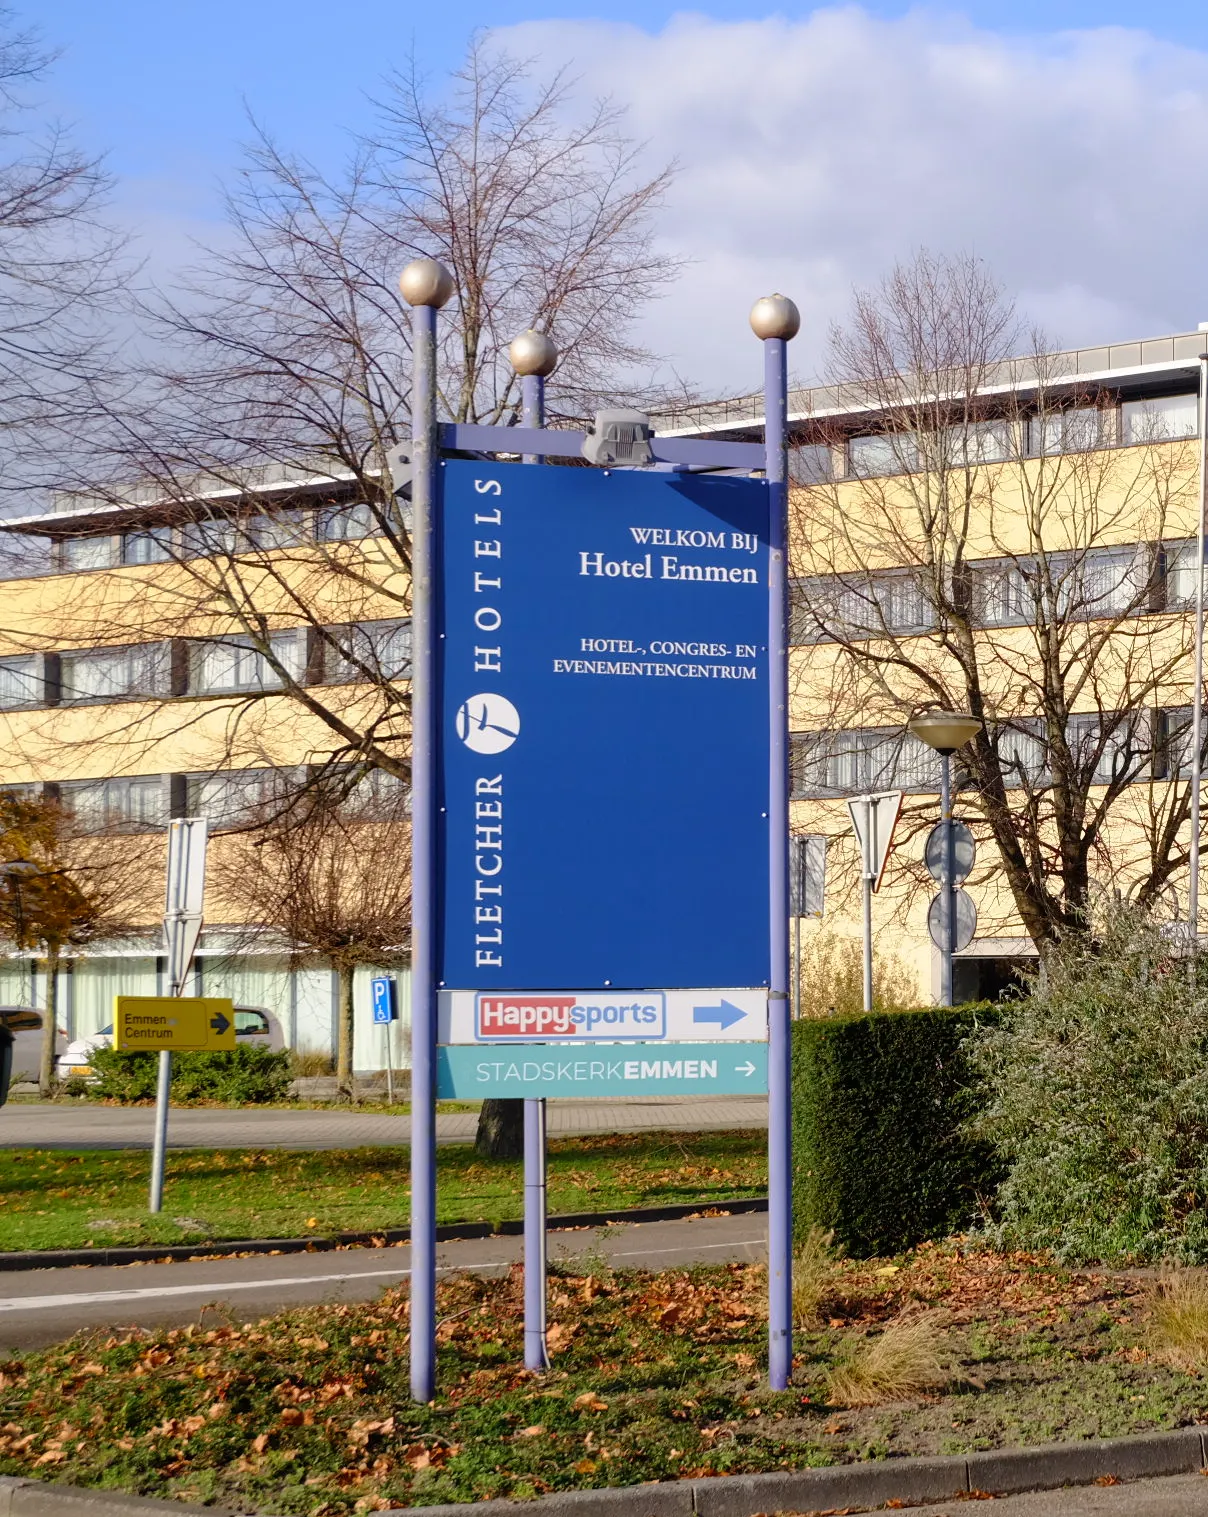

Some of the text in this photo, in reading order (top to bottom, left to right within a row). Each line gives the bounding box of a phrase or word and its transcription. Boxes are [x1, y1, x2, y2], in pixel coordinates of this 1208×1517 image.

[629, 527, 758, 553] WELKOM BIJ
[579, 552, 758, 584] Hotel Emmen
[580, 638, 757, 659] HOTEL-, CONGRES- EN
[553, 659, 757, 680] EVENEMENTENCENTRUM
[474, 478, 503, 967] FLETCHER HOTELS
[375, 982, 385, 1005] P
[124, 1013, 167, 1025] Emmen
[483, 1001, 657, 1032] Happysports
[125, 1027, 173, 1038] Centrum
[476, 1060, 717, 1082] STADSKERKEMMEN
